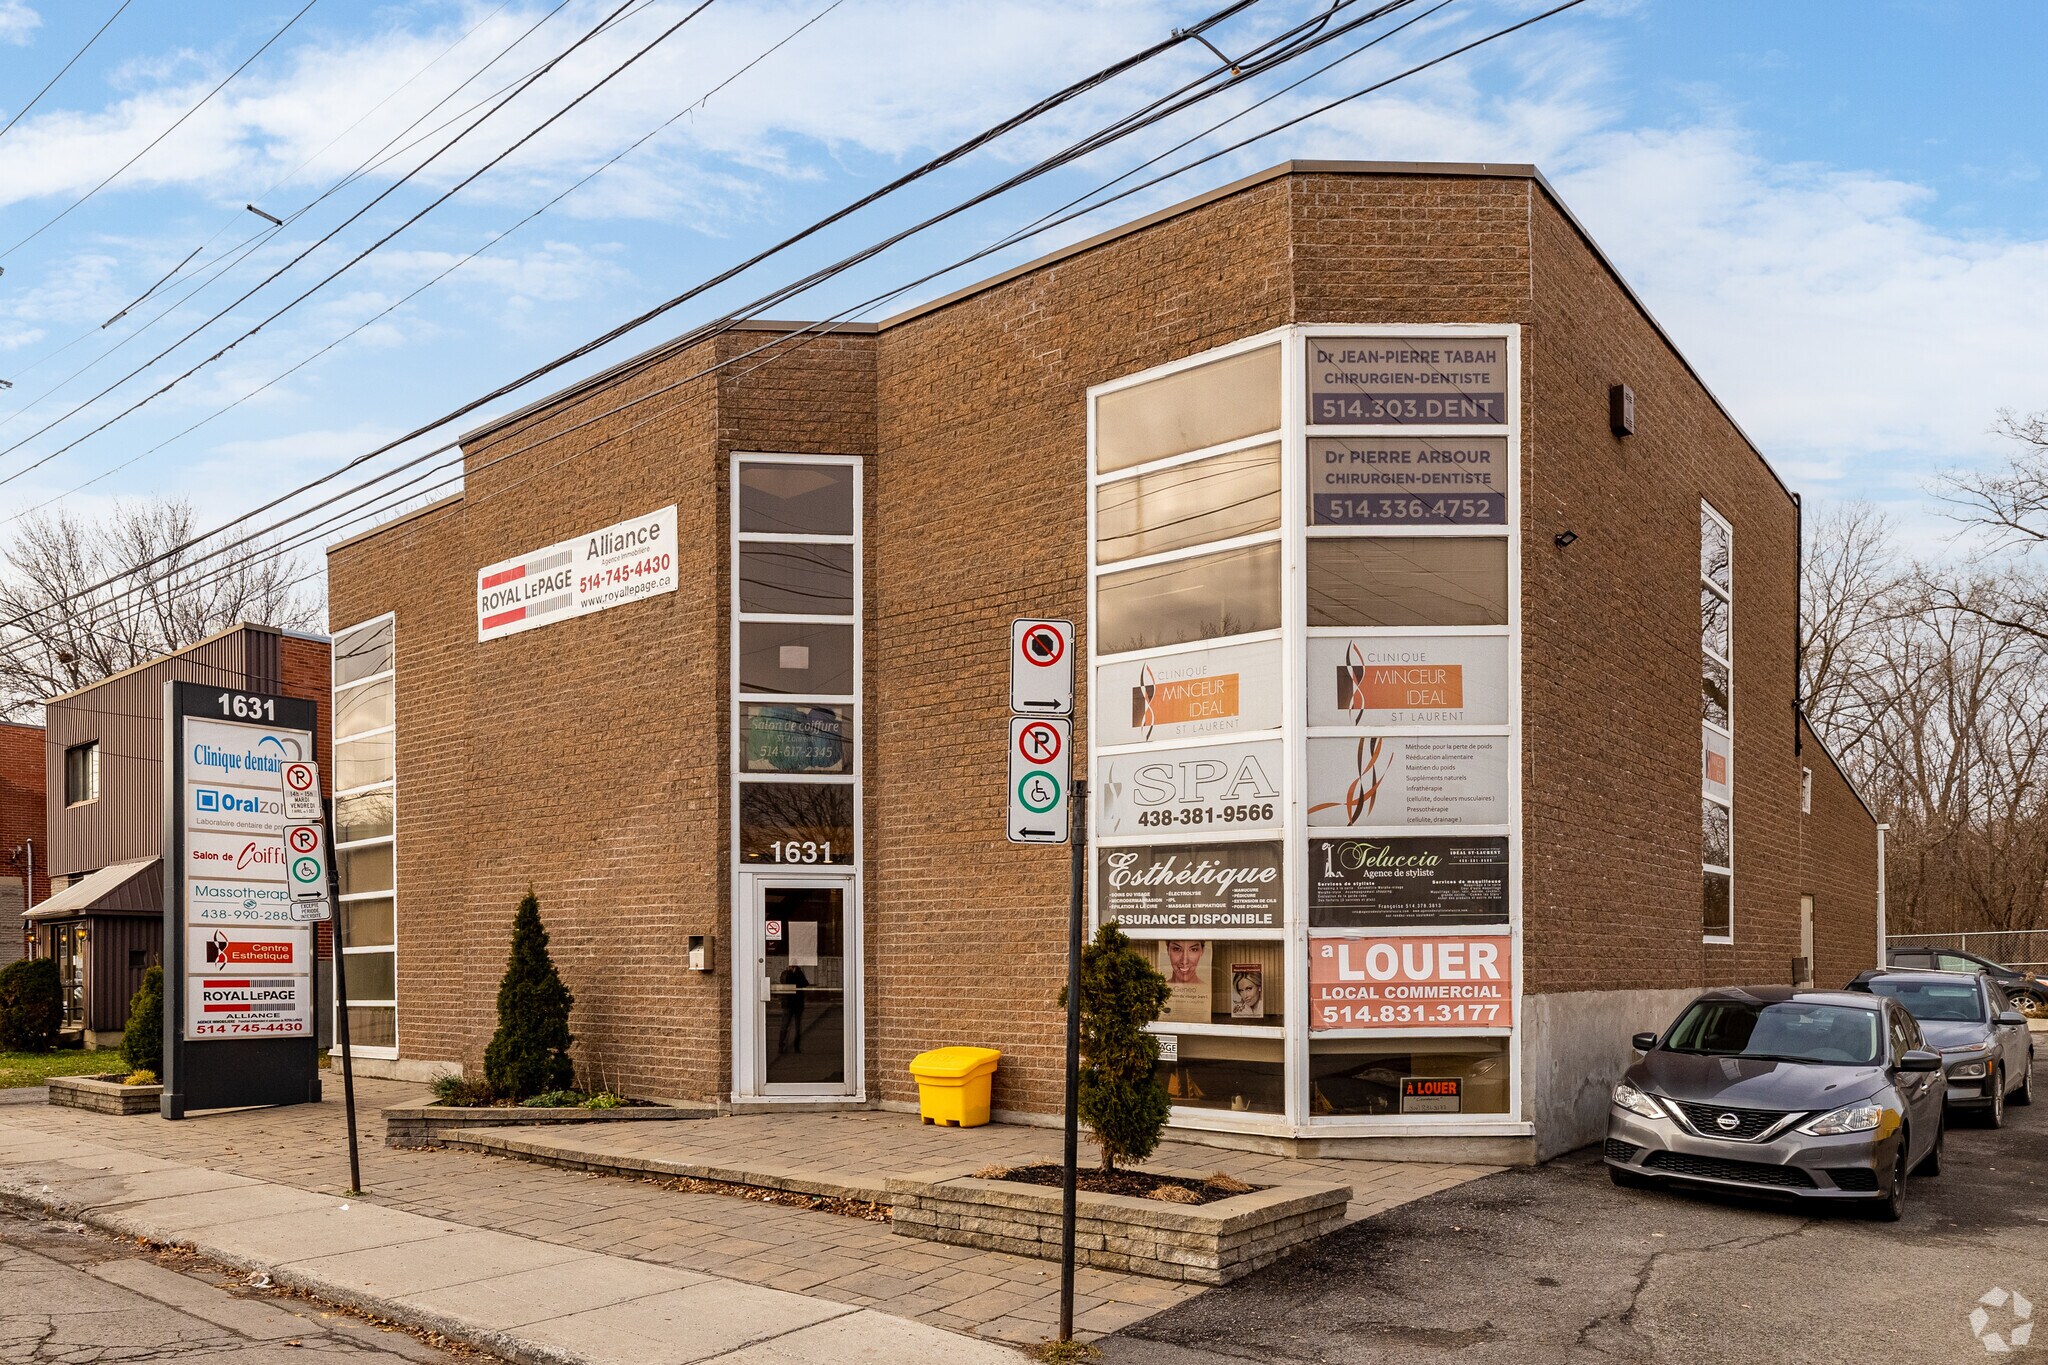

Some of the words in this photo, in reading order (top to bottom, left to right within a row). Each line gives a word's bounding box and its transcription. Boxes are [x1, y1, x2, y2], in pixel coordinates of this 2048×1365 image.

[1317, 350, 1334, 363] Dr
[1339, 350, 1440, 364] JEAN-PIERRE
[1444, 350, 1496, 363] TABAH
[1324, 372, 1490, 384] CHIRURGIEN-DENTISTE
[1322, 399, 1494, 418] 514.303.DENT
[1325, 451, 1344, 463] Dr
[1350, 451, 1411, 463] PIERRE
[1417, 450, 1491, 463] ARBOUR
[1325, 472, 1492, 484] CHIRURGIEN-DENTISTE
[1330, 499, 1490, 518] 514.336.4752
[587, 522, 661, 561] Alliance
[601, 554, 621, 566] Agence
[579, 553, 671, 594] 514-745-4430
[482, 586, 521, 612] ROYAL
[580, 576, 671, 608] www.royallepage.ca
[1368, 652, 1426, 662] CLINIQUE
[1157, 665, 1207, 681] CLINIQUE
[1374, 669, 1447, 685] MINCEUR
[1162, 679, 1225, 702] MINCEUR
[1406, 689, 1447, 705] IDEAL
[218, 692, 275, 721] 1631
[1189, 701, 1225, 718] IDEAL
[1391, 712, 1403, 722] ST
[1411, 711, 1465, 722] LAURENT
[752, 719, 783, 730] Salon
[784, 720, 798, 731] de
[798, 720, 840, 734] coiffure
[1175, 725, 1187, 735] ST
[1192, 718, 1241, 733] LAURENT
[193, 744, 241, 773] Clinique
[244, 750, 282, 773] dentair
[760, 746, 833, 758] 514-617-2345
[1133, 755, 1280, 807] SPA
[221, 793, 284, 815] Oralzo
[1138, 803, 1274, 827] 438-381-9566
[196, 817, 235, 828] Laboratoire
[236, 820, 263, 830] dentaire
[264, 822, 272, 830] de
[193, 851, 219, 860] Salon
[222, 852, 233, 861] de
[237, 842, 286, 870] Coiffu
[770, 841, 833, 863] 1631
[1337, 841, 1443, 870] Teluccia
[1107, 852, 1277, 897] Esthétique
[1363, 869, 1393, 879] Agence
[1394, 869, 1404, 877] de
[1405, 868, 1435, 878] styliste
[195, 885, 289, 901] Massotherap
[201, 909, 291, 920] 438-990-288
[1110, 914, 1186, 925] ASSURANCE
[1189, 913, 1272, 924] DISPONIBLE
[232, 952, 290, 960] Esthetique
[252, 944, 289, 952] Centre
[1338, 943, 1501, 981] LOUER
[203, 991, 249, 1001] ROYAL
[1321, 986, 1379, 999] LOCAL
[1384, 985, 1502, 999] COMMERCIAL
[1322, 1004, 1500, 1023] 514.831.3177
[197, 1025, 226, 1033] 514
[232, 1023, 303, 1033] 745-4430
[1160, 1043, 1176, 1052] AGE
[1417, 1081, 1457, 1095] LOUER
